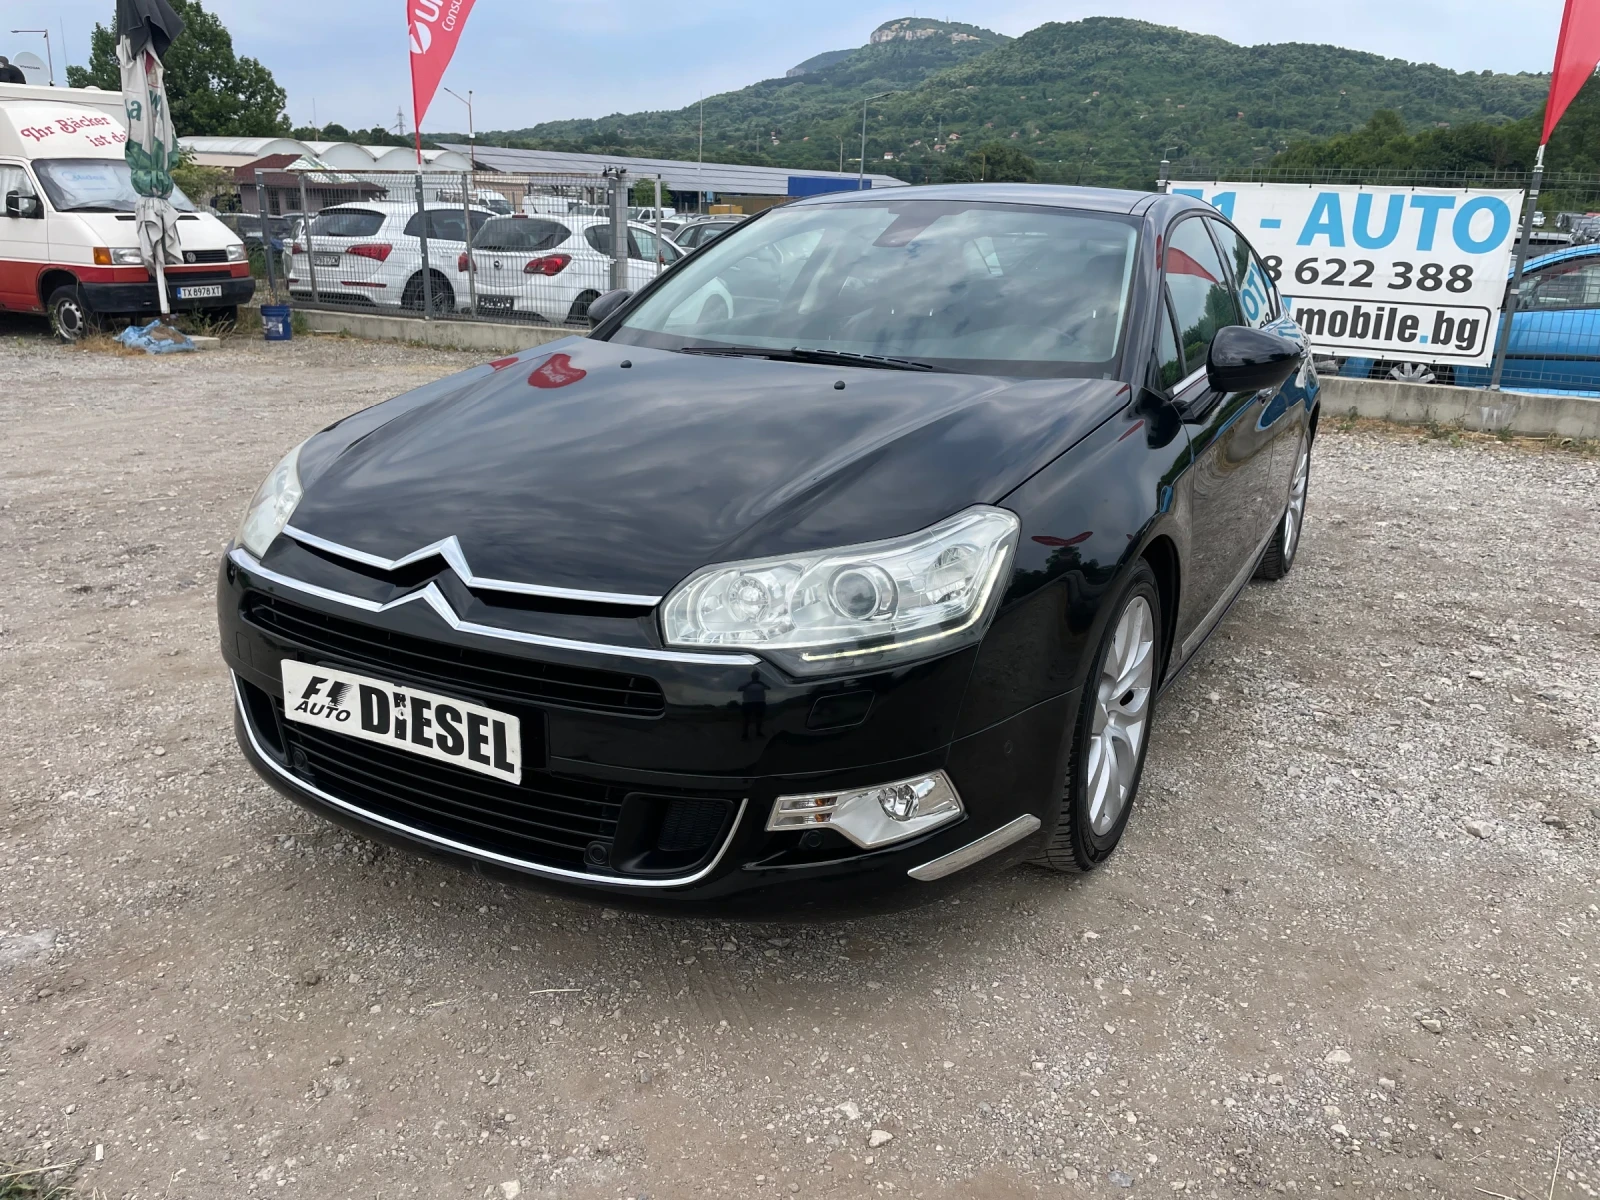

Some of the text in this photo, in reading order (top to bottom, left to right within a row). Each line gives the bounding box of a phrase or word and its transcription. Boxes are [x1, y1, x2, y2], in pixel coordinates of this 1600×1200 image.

[55, 115, 111, 134] Bäcker
[85, 134, 112, 147] ist
[1296, 192, 1511, 254] AUTO
[1295, 257, 1374, 288] 622
[1387, 261, 1474, 294] 388
[1295, 305, 1480, 351] mobile.bg
[301, 675, 354, 708] F1
[294, 700, 351, 722] AUTO
[359, 683, 515, 774] DIESEL
